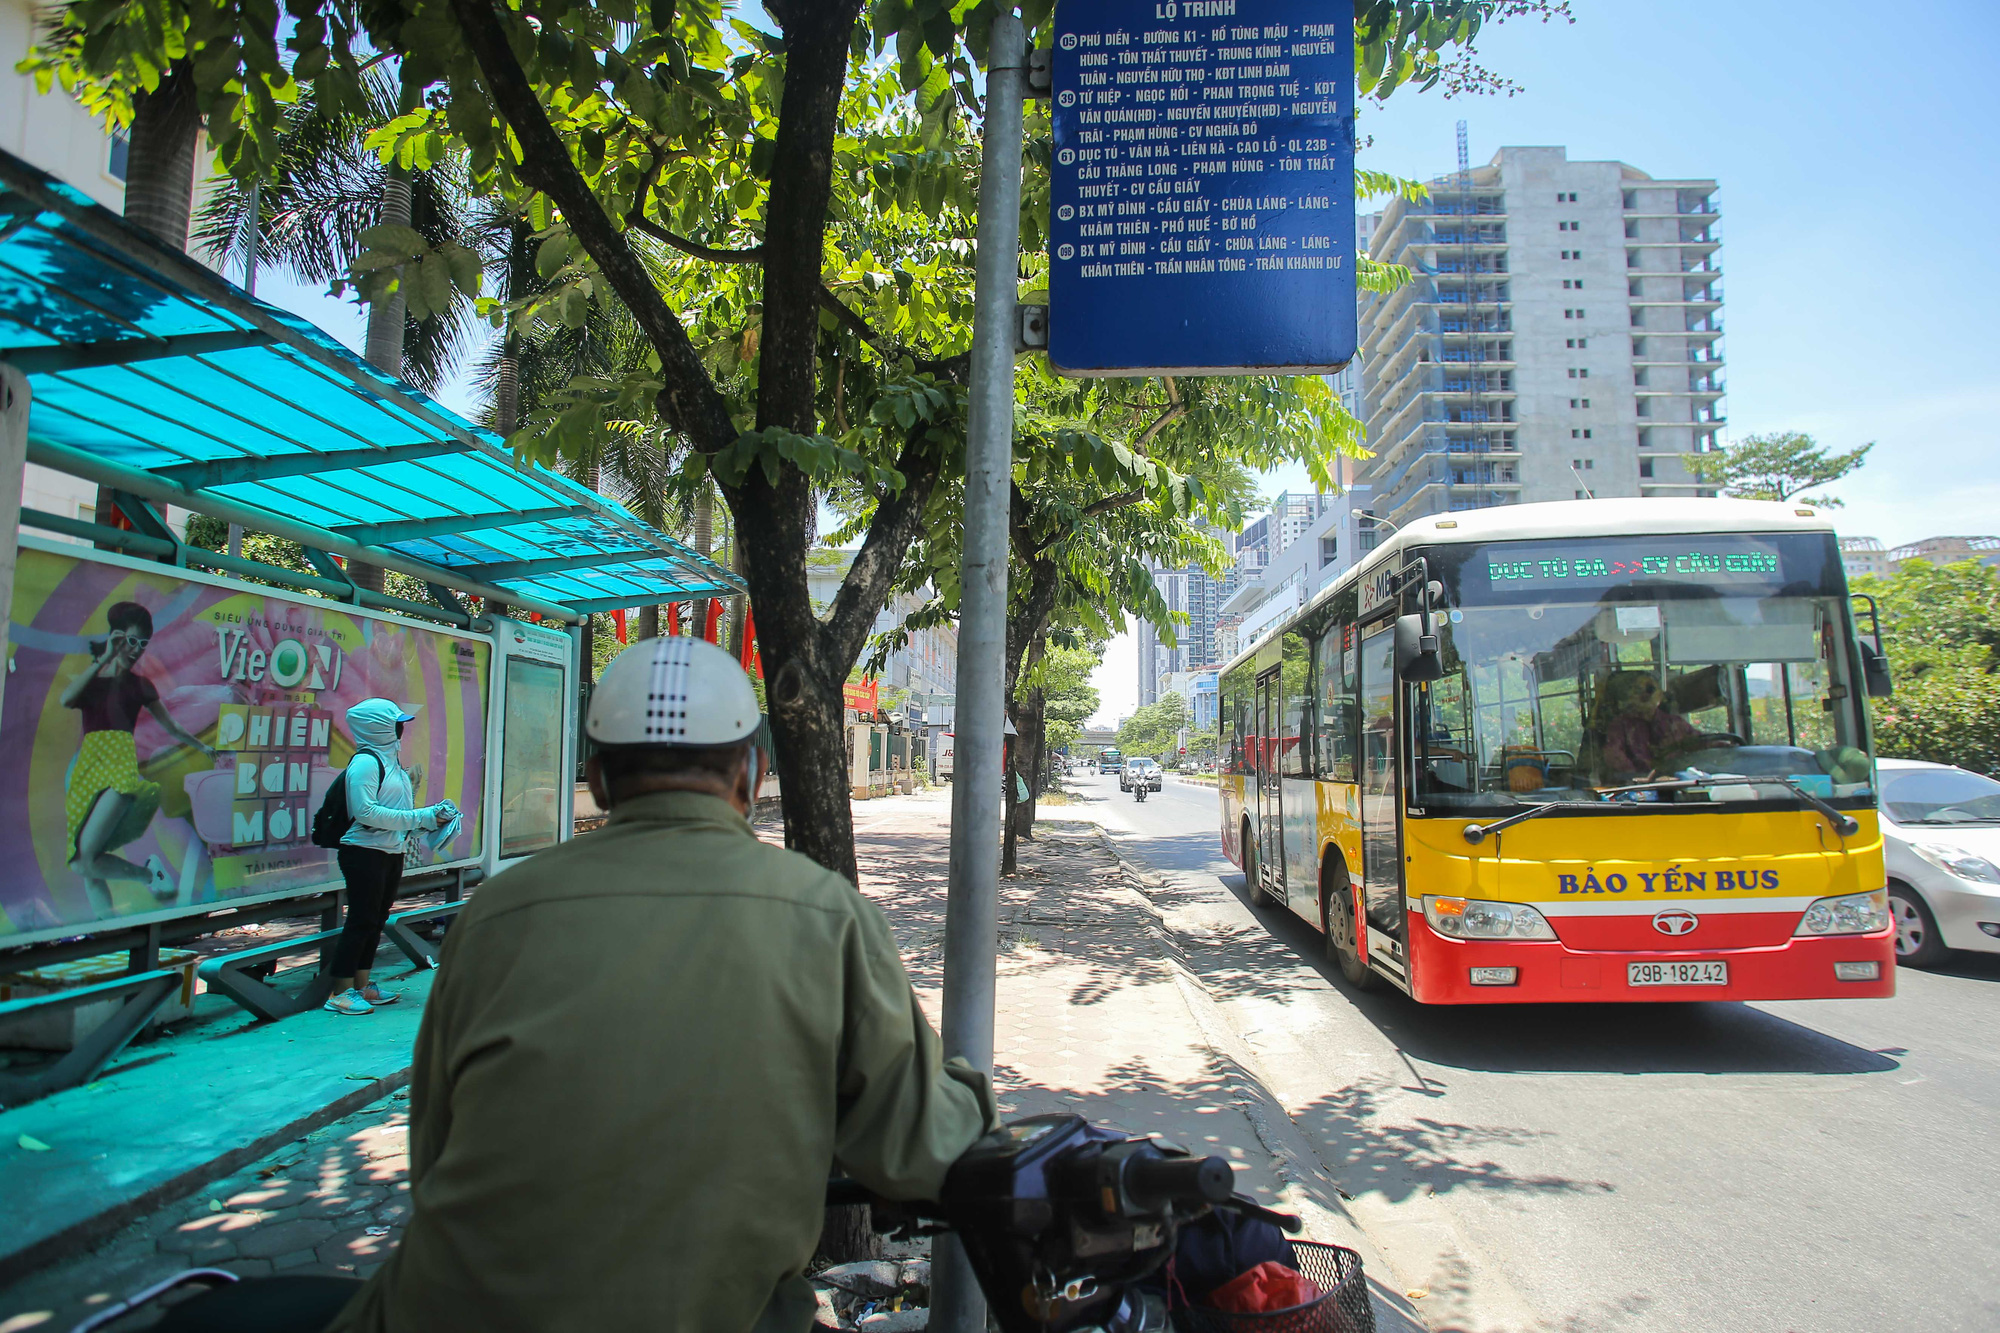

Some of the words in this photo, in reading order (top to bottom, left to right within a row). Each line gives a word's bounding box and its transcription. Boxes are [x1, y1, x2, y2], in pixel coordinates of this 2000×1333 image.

[1063, 37, 1074, 47] 05
[1080, 31, 1101, 47] PHÚ
[1105, 28, 1130, 46] DIỄN
[1143, 29, 1179, 44] ĐƯỜNG
[1184, 30, 1197, 43] K1
[1231, 25, 1259, 41] TÙNG
[1263, 22, 1288, 42] MẬU
[1302, 24, 1334, 40] PHẠM
[1080, 51, 1108, 67] HÙNG
[1118, 49, 1139, 65] TÔN
[1141, 46, 1167, 64] THẤT
[1169, 45, 1208, 63] THUYẾT
[1217, 47, 1252, 61] TRUNG
[1255, 43, 1281, 59] KÍNH
[1291, 38, 1335, 57] NGUYỄN
[1079, 70, 1107, 86] TUÂN
[1116, 65, 1158, 84] NGUYỄN
[1161, 67, 1182, 83] HỮU
[1185, 68, 1205, 84] THỌ
[1215, 67, 1235, 80] KĐT
[1238, 65, 1262, 79] LINH
[1265, 61, 1290, 78] ĐÀM
[1061, 93, 1073, 104] 39
[1097, 88, 1122, 106] HIỆP
[1136, 88, 1165, 104] NGỌC
[1203, 86, 1233, 100] PHAN
[1238, 85, 1275, 100] TRỌNG
[1279, 80, 1300, 98] TUỆ
[1314, 82, 1336, 95] KĐT
[1080, 108, 1101, 124] VĂN
[1167, 103, 1211, 120] NGUYỄN
[1291, 96, 1337, 115] NGUYỄN
[1079, 128, 1103, 143] TRÃI
[1113, 128, 1145, 143] PHẠM
[1148, 124, 1178, 140] HÙNG
[1188, 126, 1203, 137] CV
[1206, 122, 1239, 137] NGHĨA
[1242, 121, 1258, 135] ĐÔ
[1061, 152, 1073, 161] 61
[1104, 144, 1118, 160] TÚ
[1129, 144, 1151, 158] VÂN
[1155, 142, 1170, 156] HÀ
[1181, 141, 1207, 155] LIÊN
[1210, 140, 1225, 154] HÀ
[1236, 141, 1260, 154] CAO
[1288, 140, 1302, 153] QL
[1305, 139, 1327, 151] 23B
[1106, 162, 1143, 178] THĂNG
[1148, 163, 1177, 176] LONG
[1193, 161, 1226, 176] PHẠM
[1232, 158, 1264, 172] HÙNG
[1279, 156, 1302, 171] TÔN
[1307, 153, 1335, 171] THẤT
[1079, 180, 1119, 198] THUYẾT
[1131, 183, 1145, 195] CV
[1175, 177, 1200, 193] GIẤY
[1080, 205, 1094, 217] BX
[1098, 201, 1115, 216] MỸ
[1118, 201, 1145, 215] ĐÌNH
[1184, 196, 1210, 212] GIẤY
[1222, 195, 1253, 211] CHÙA
[1256, 195, 1287, 210] LÁNG
[1298, 193, 1329, 209] LÁNG
[1080, 221, 1113, 237] KHÂM
[1117, 219, 1150, 235] THIÊN
[1161, 216, 1185, 233] PHỐ
[1188, 215, 1211, 231] HUẾ
[1080, 244, 1094, 257] BX
[1100, 241, 1115, 256] MỸ
[1120, 240, 1146, 255] ĐÌNH
[1186, 236, 1211, 252] GIẤY
[1225, 235, 1254, 251] CHÙA
[1259, 234, 1287, 250] LÁNG
[1301, 234, 1330, 249] LÁNG
[1081, 262, 1112, 278] KHÂM
[1114, 261, 1145, 276] THIÊN
[1185, 258, 1215, 273] NHÂN
[1218, 257, 1246, 272] TÔNG
[1287, 254, 1323, 270] KHÁNH
[219, 711, 330, 747] PHIÊN
[233, 801, 306, 844] MỚI
[1558, 867, 1628, 894] BẢO
[1638, 864, 1707, 893] YẾN
[1716, 869, 1779, 891] BUS
